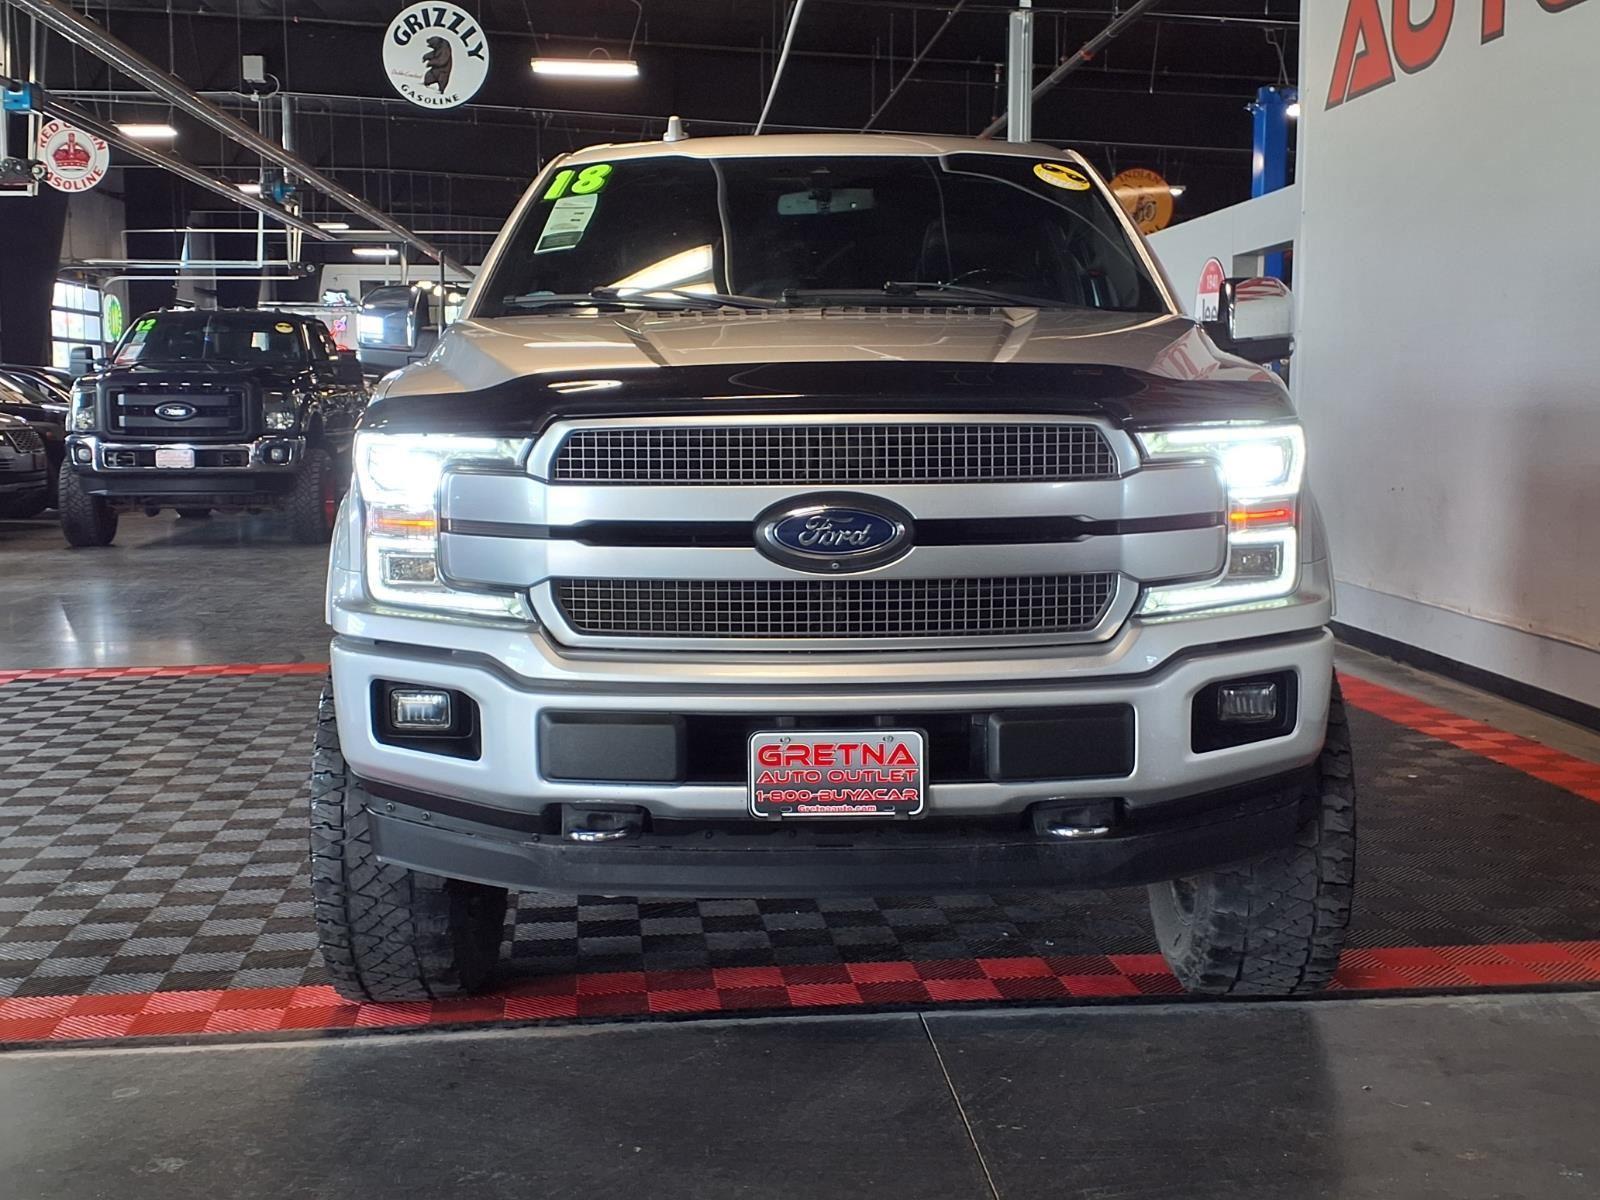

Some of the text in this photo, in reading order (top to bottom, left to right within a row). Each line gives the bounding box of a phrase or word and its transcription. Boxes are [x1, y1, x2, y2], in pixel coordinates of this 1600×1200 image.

[393, 7, 485, 61] GRIZZLY
[1324, 0, 1588, 111] AU
[400, 84, 460, 105] GASOLINE
[45, 165, 104, 190] ASOLINE
[543, 163, 613, 200] 18
[135, 319, 156, 331] 12
[798, 514, 873, 546] Ford
[757, 743, 918, 767] GRETNA
[756, 768, 919, 784] AUTO OUTLET
[756, 788, 919, 803] 1-800-BUYACAR
